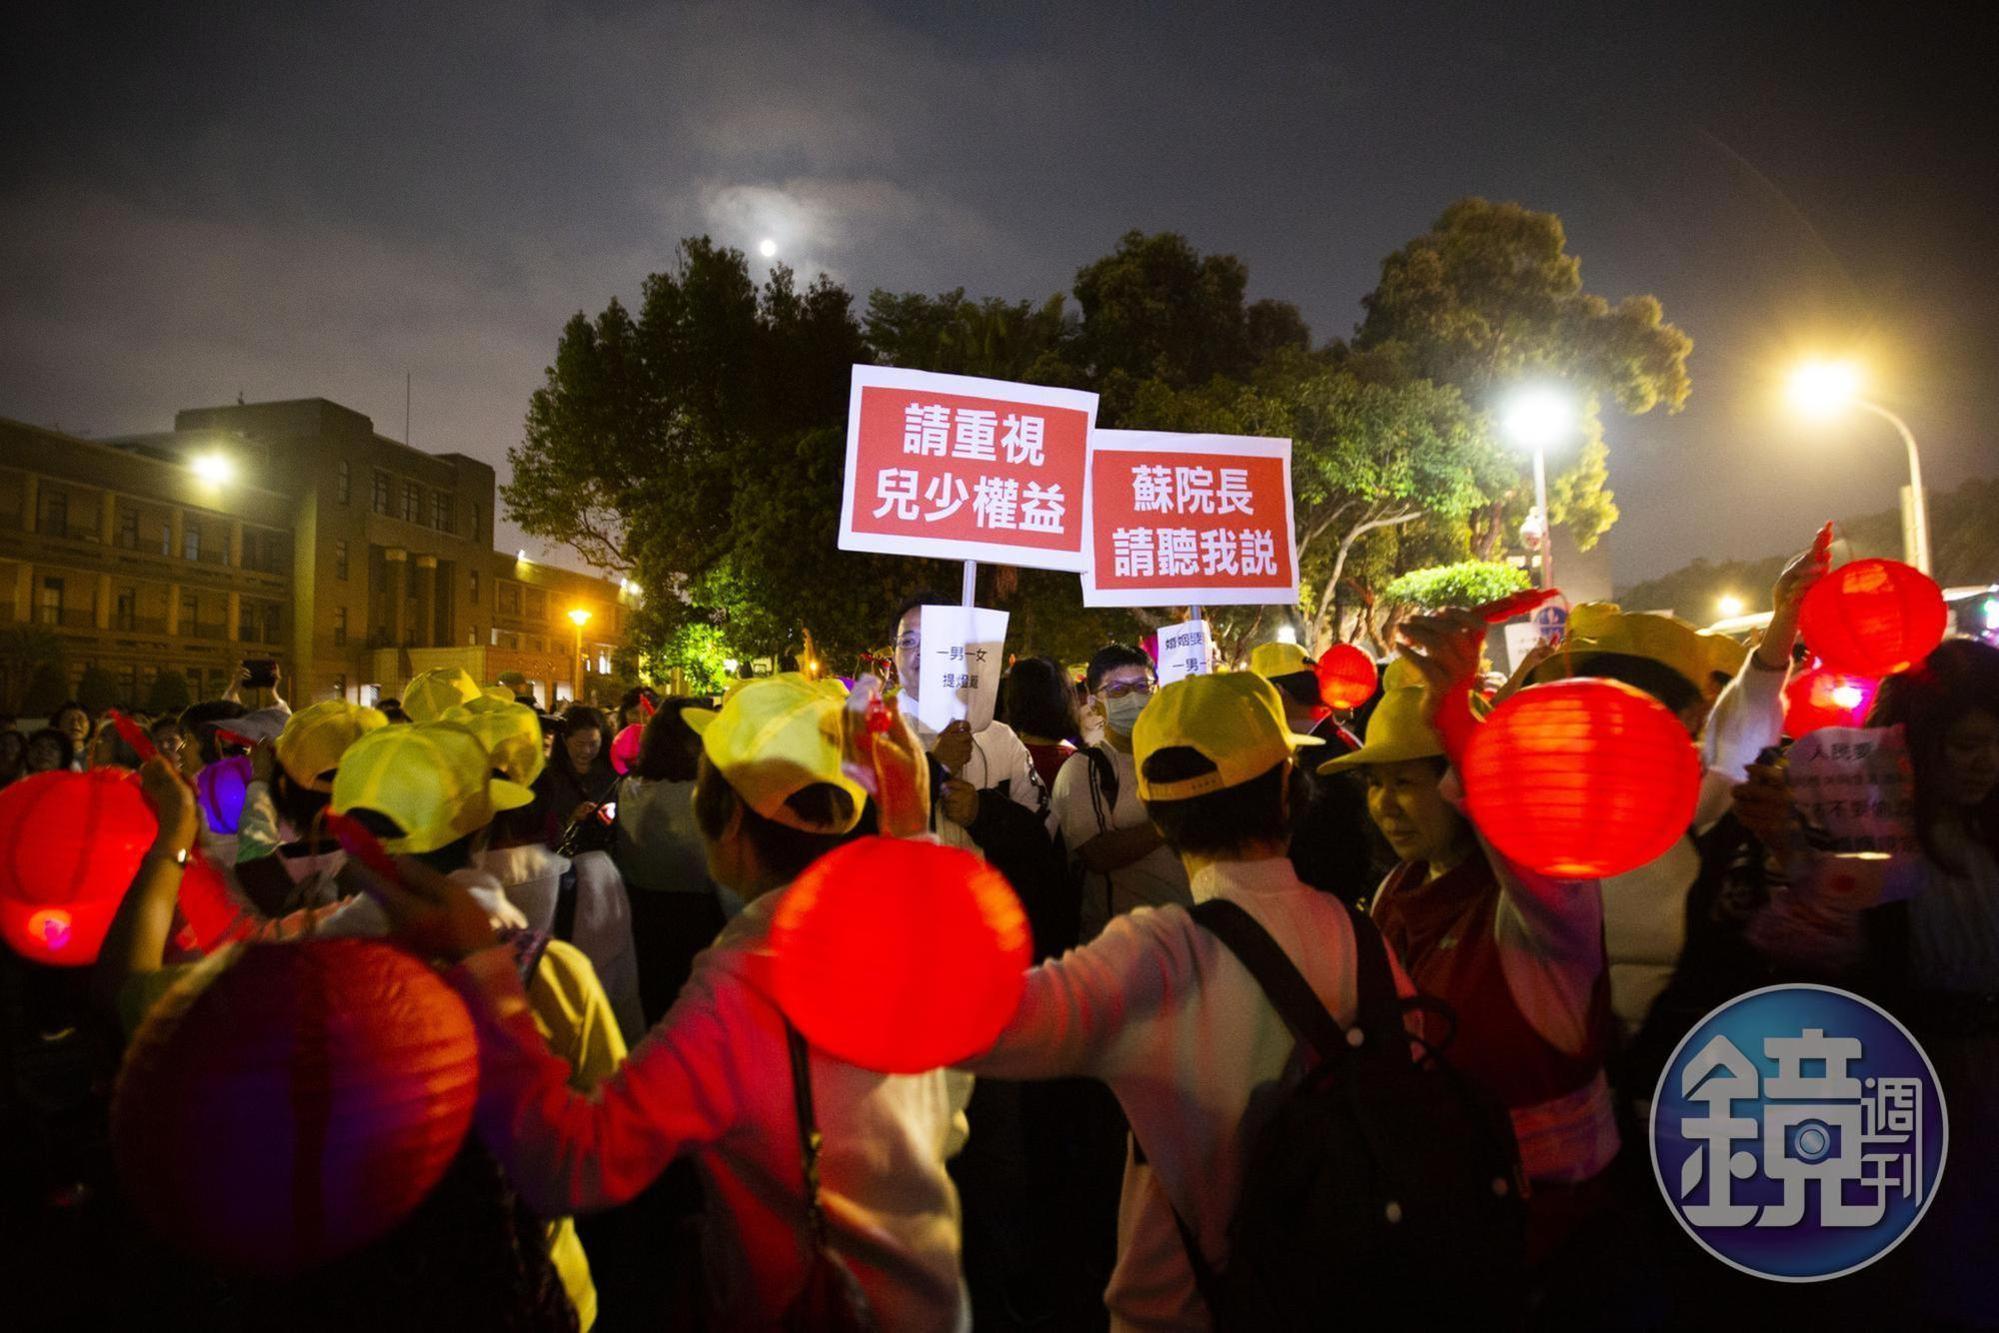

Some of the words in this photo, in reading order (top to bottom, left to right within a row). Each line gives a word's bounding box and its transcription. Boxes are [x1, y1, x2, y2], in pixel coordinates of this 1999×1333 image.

[902, 402, 1045, 467] 請重視
[872, 468, 1065, 535] 兒少權益
[1132, 465, 1254, 515] 蘇院長
[936, 646, 987, 662] 一男一女
